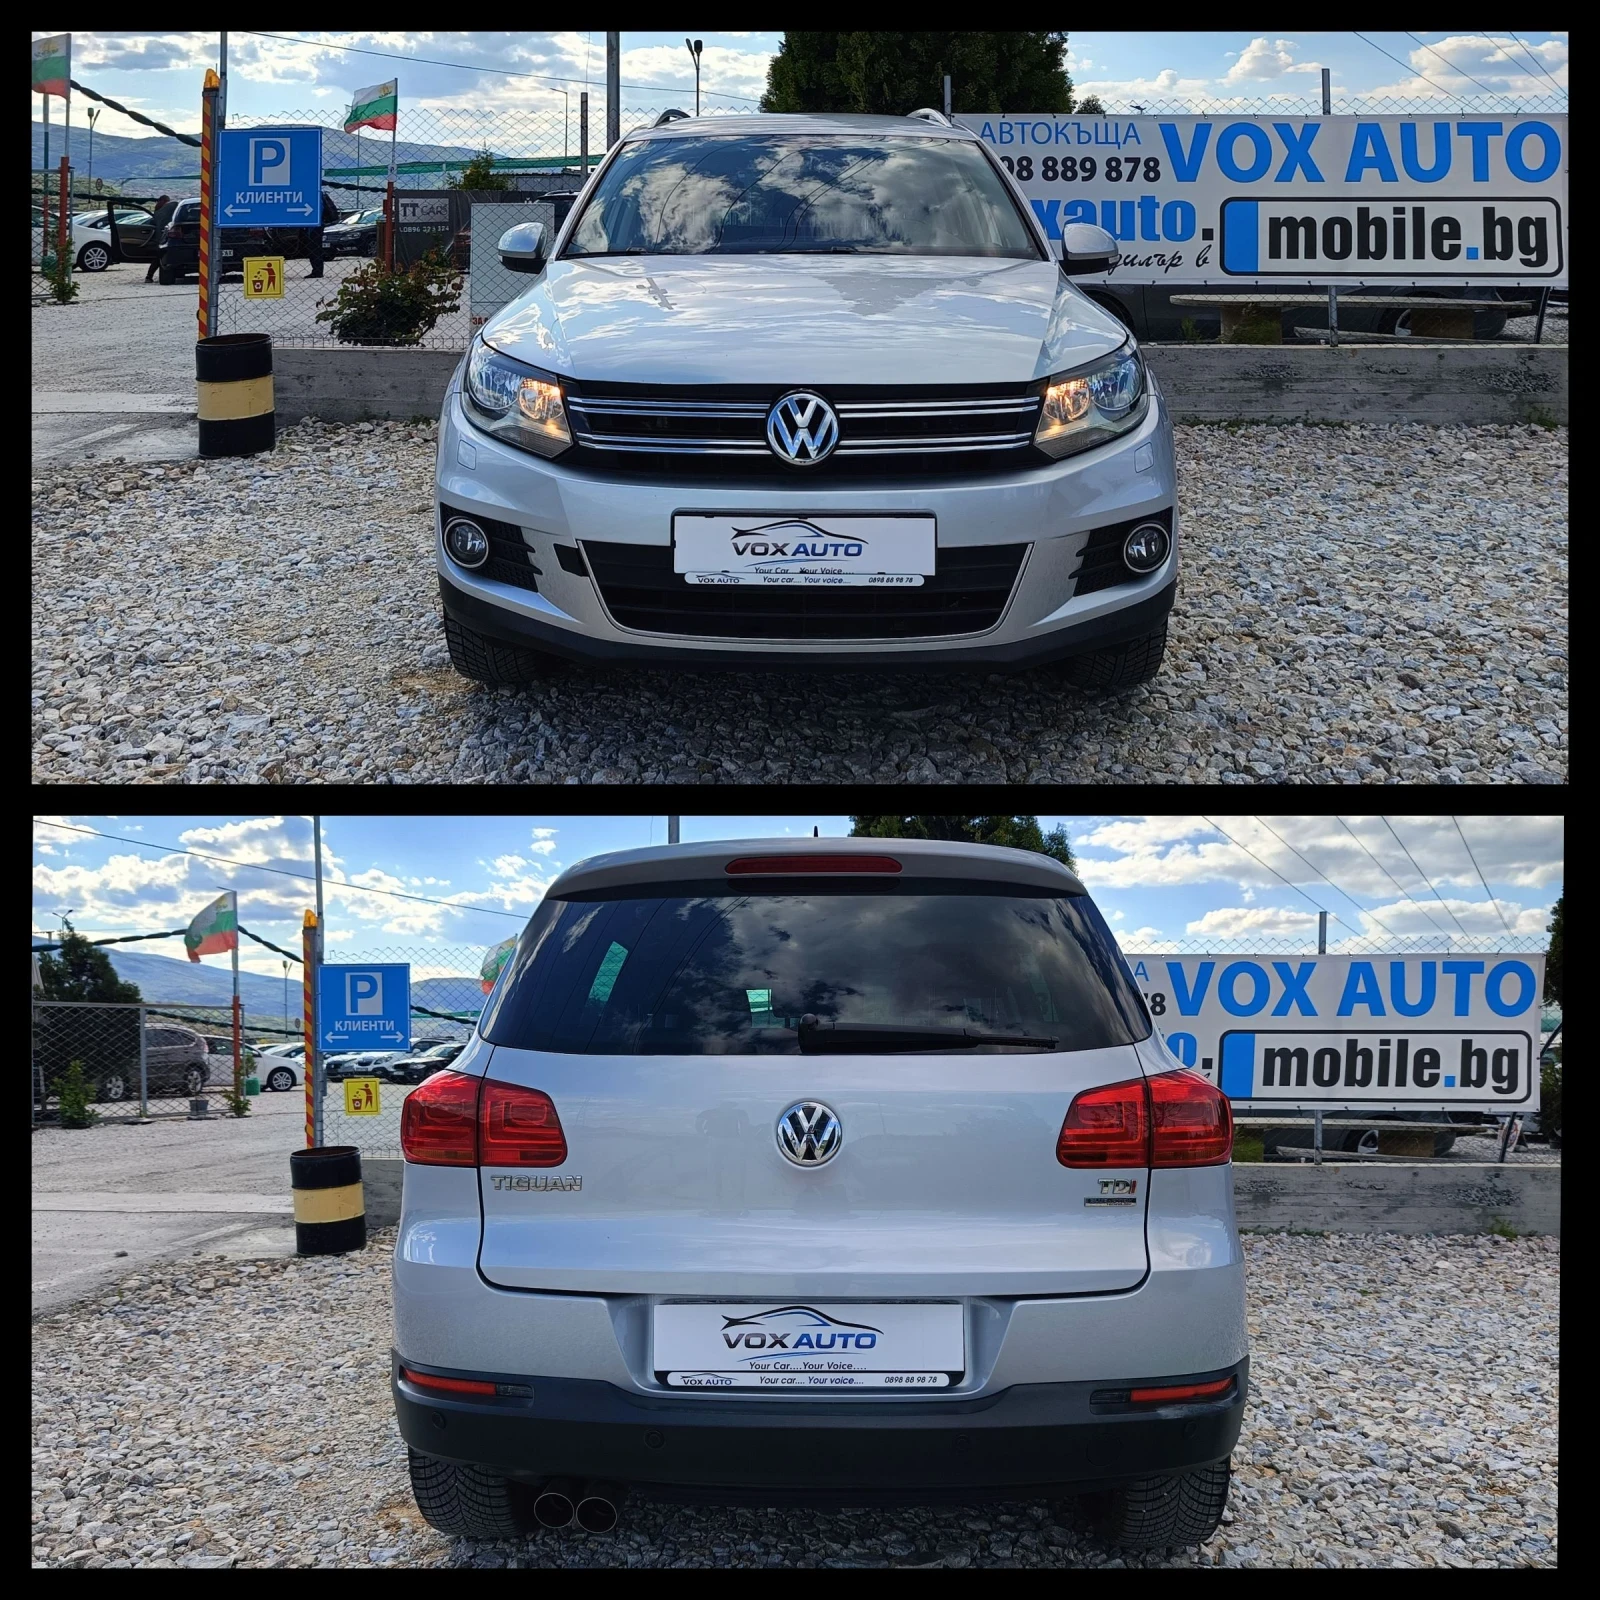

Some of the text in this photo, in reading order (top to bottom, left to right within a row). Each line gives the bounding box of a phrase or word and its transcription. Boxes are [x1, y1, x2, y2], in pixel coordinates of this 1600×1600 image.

[980, 121, 1141, 149] АВТОКЪЩА
[1160, 121, 1561, 183] VOX AUTO
[1041, 156, 1098, 182] 889
[1105, 156, 1161, 183] 878
[235, 191, 303, 204] КЛИЕНТИ
[1268, 206, 1549, 268] mobile.bg
[804, 576, 822, 584] Your
[1166, 961, 1318, 1018] VOX
[1336, 961, 1537, 1018] AUTO
[334, 1020, 395, 1032] КЛИЕНТИ
[1262, 1038, 1519, 1095] mobile.bg
[490, 1174, 583, 1192] TIGUAN
[1097, 1178, 1137, 1194] TDI
[749, 1361, 770, 1370] Your
[683, 1378, 703, 1386] VOX
[705, 1378, 732, 1386] AUTO
[759, 1375, 779, 1384] Your
[808, 1376, 828, 1385] Your
[884, 1376, 904, 1384] 0898
[905, 1376, 915, 1384] 88
[916, 1376, 926, 1384] 98
[928, 1376, 938, 1384] 78
